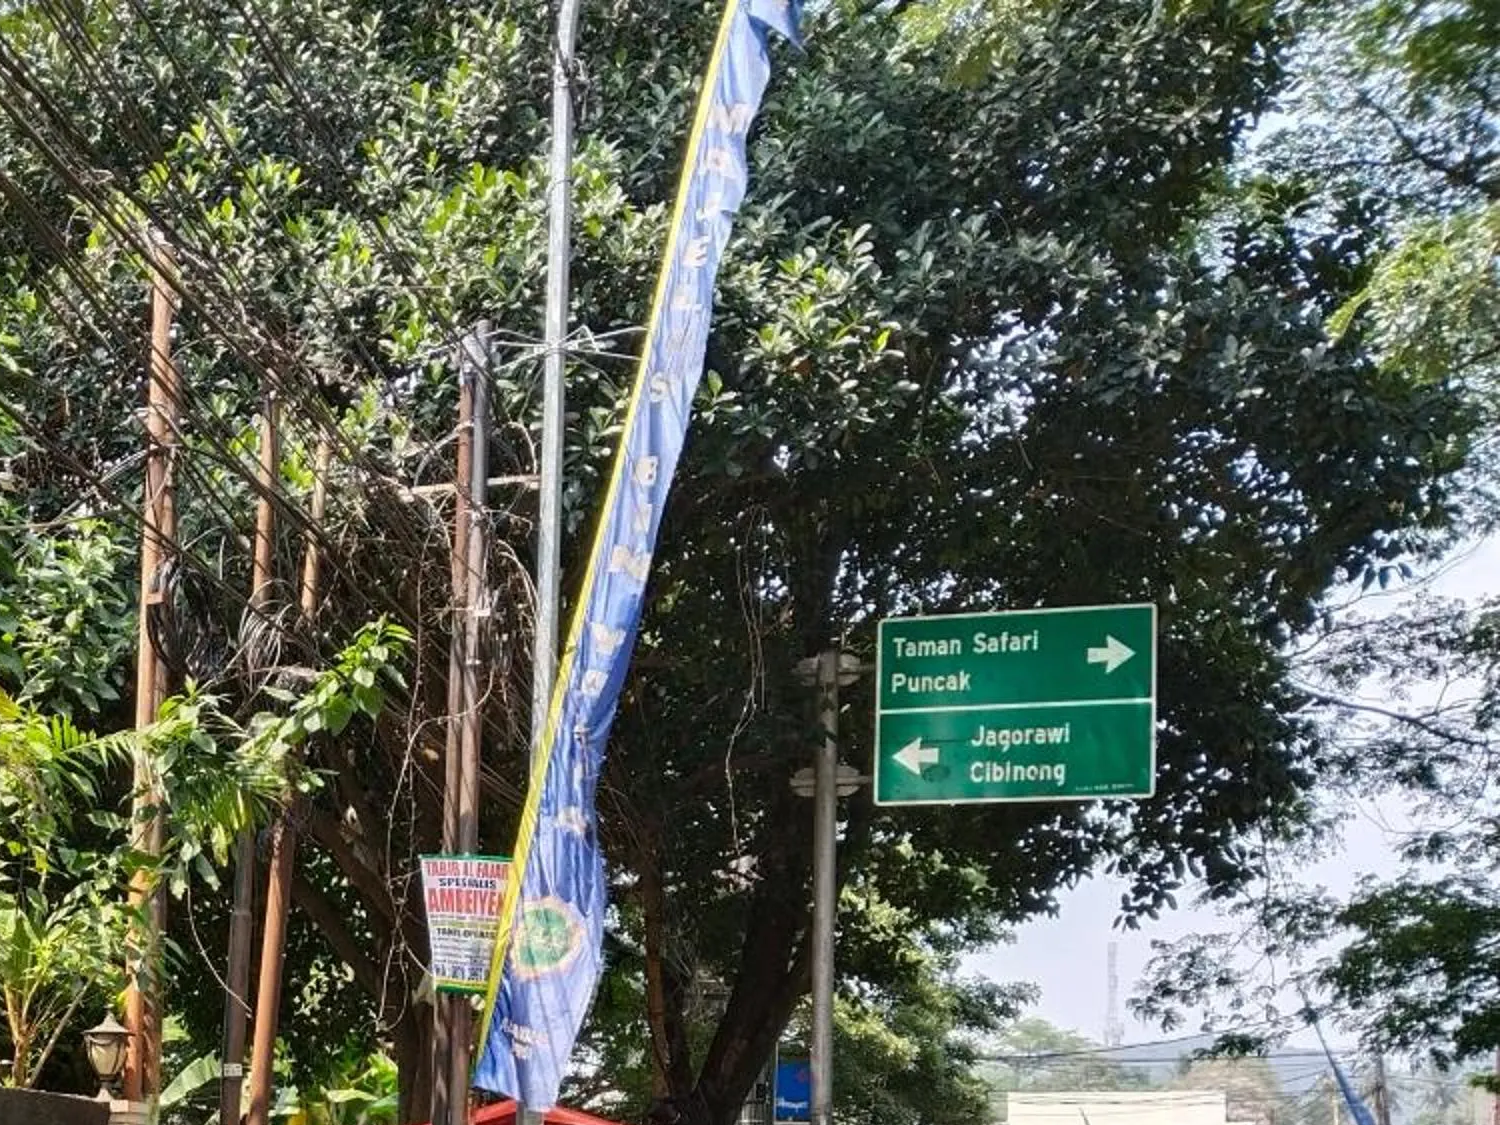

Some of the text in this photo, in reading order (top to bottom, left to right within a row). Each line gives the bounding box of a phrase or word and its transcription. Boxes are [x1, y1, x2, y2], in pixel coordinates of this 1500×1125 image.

[893, 630, 1039, 658] Taman Safari
[891, 670, 971, 693] Puncak
[971, 722, 1071, 752] Jagorawi
[970, 762, 1066, 787] Cibinong
